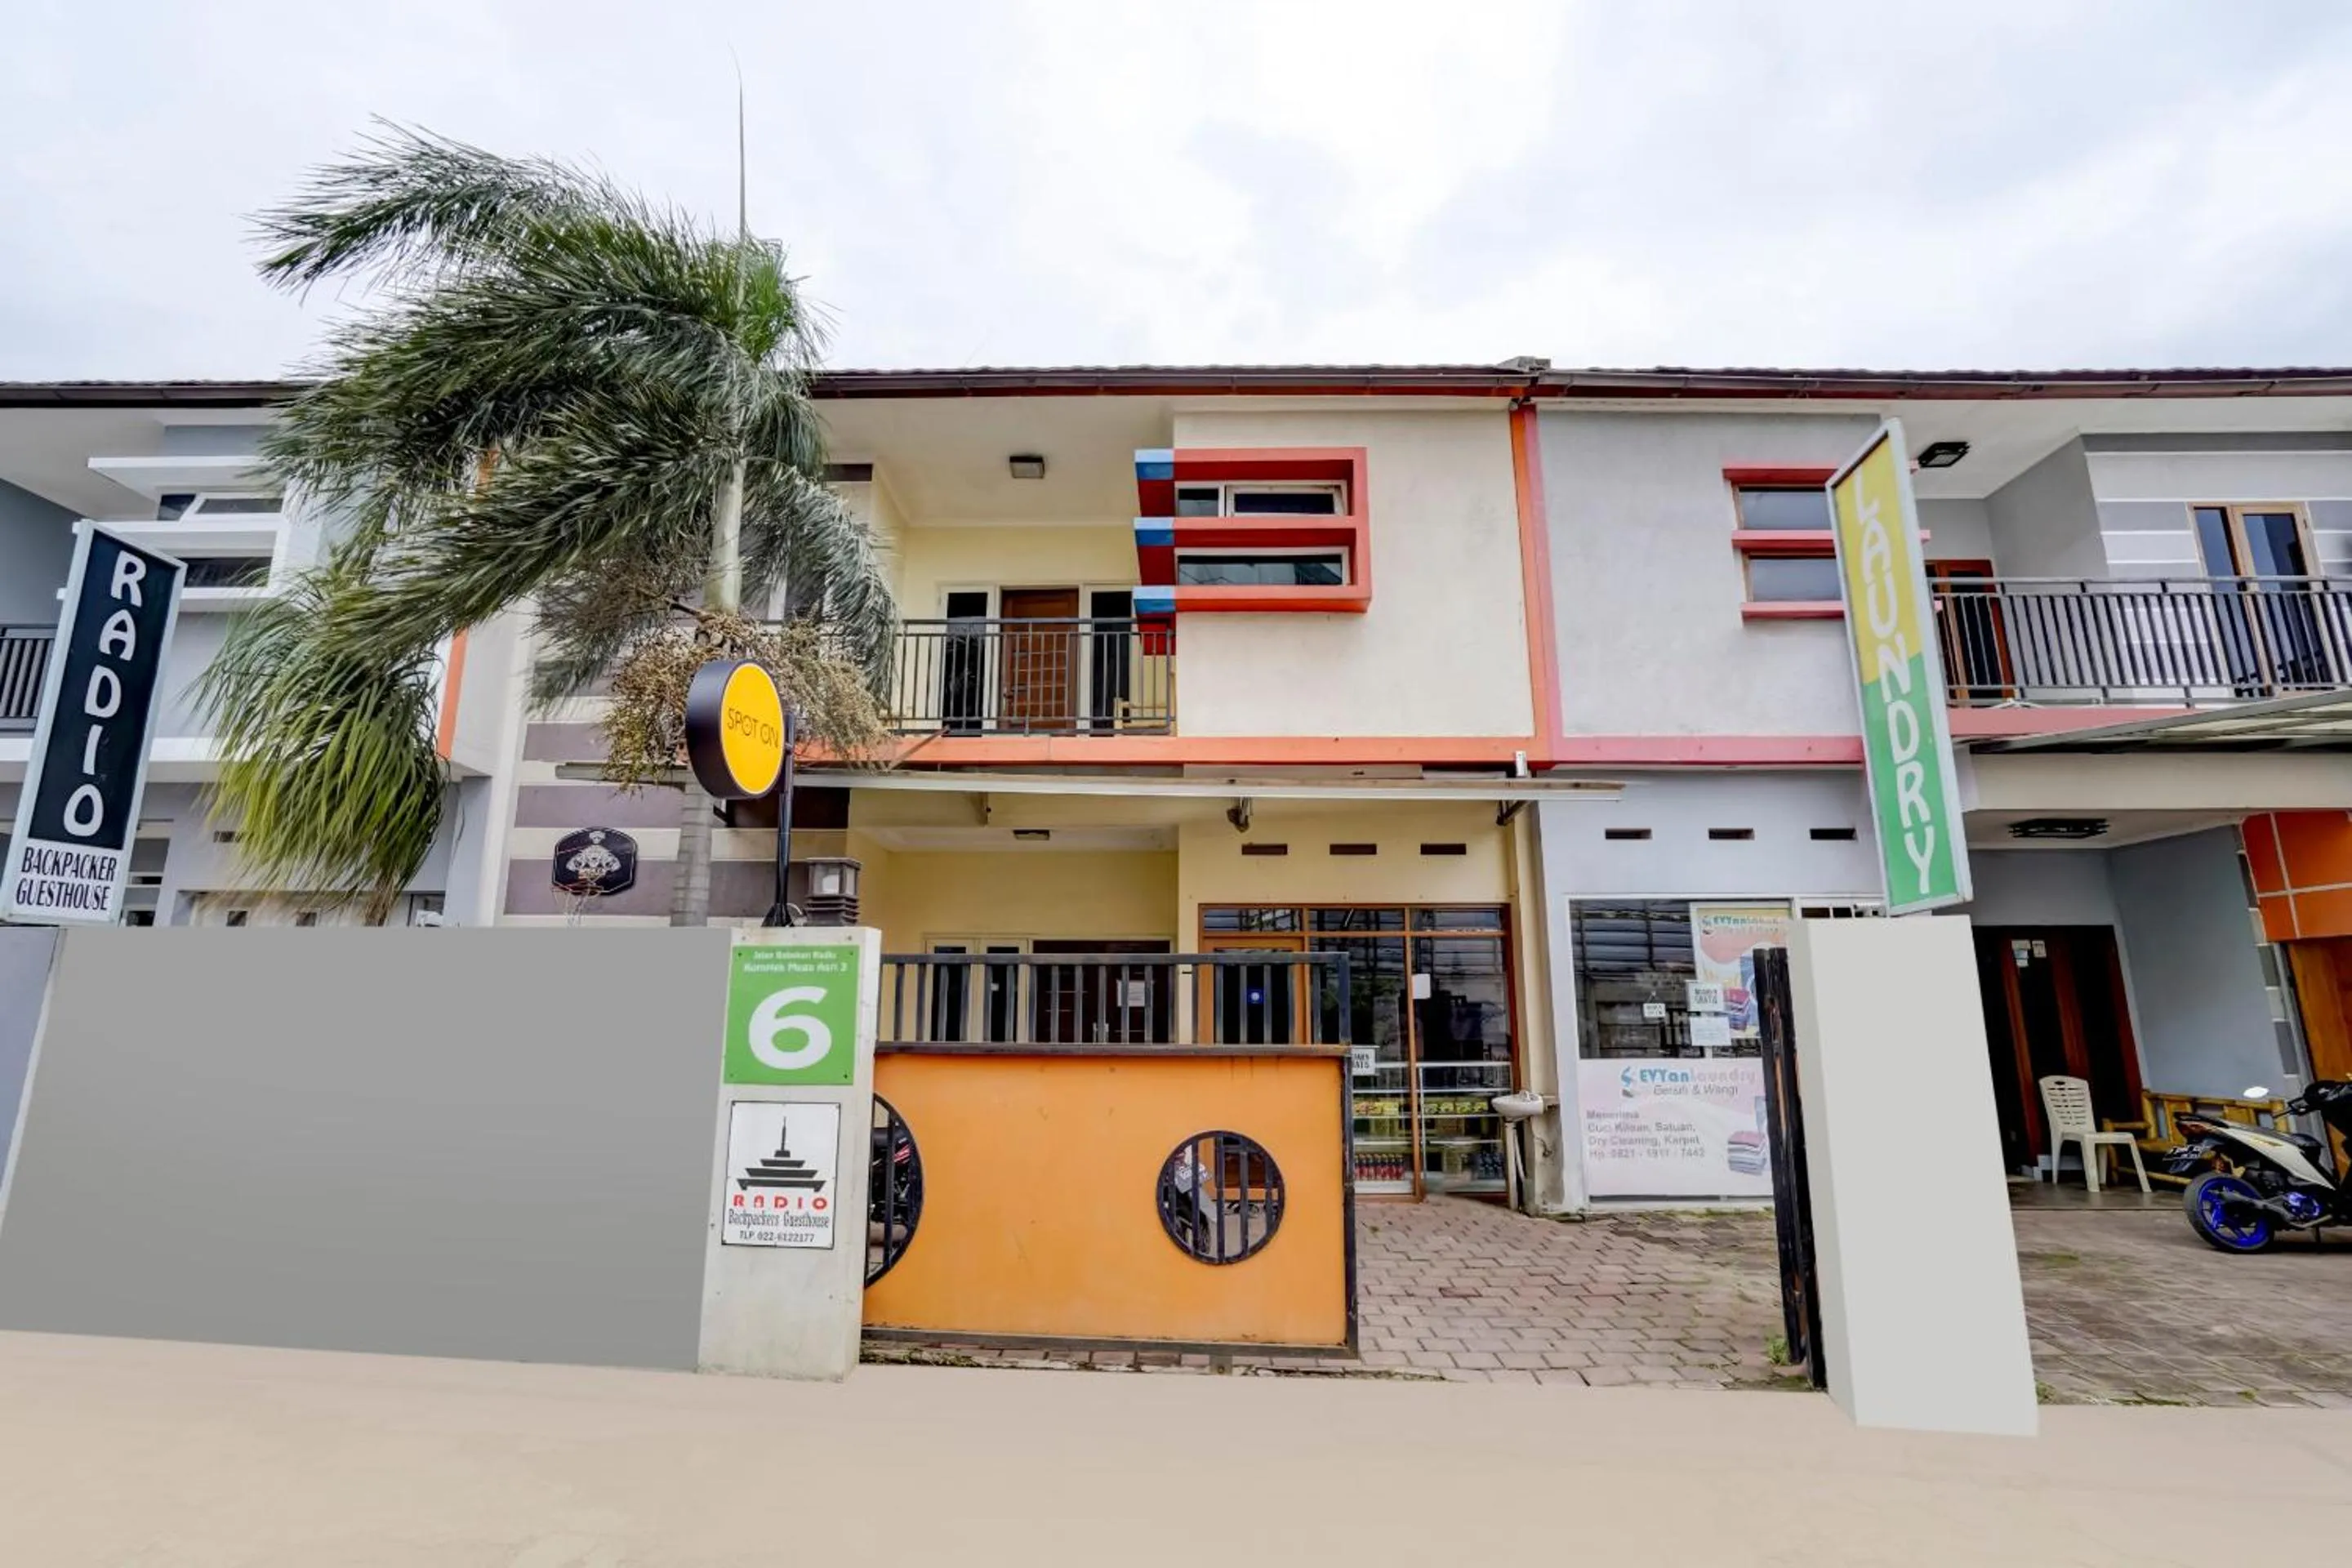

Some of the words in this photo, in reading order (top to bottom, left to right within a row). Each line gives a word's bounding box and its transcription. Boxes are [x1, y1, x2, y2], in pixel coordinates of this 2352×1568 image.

[64, 550, 146, 837] RADIO
[1855, 467, 1935, 894] LAUNDRY
[727, 707, 758, 736] SPOT
[760, 724, 779, 748] ON
[21, 846, 117, 883] BACKPACKER
[16, 877, 111, 911] GUESTHOUSE
[748, 986, 832, 1070] 6
[733, 1194, 828, 1210] RADIO
